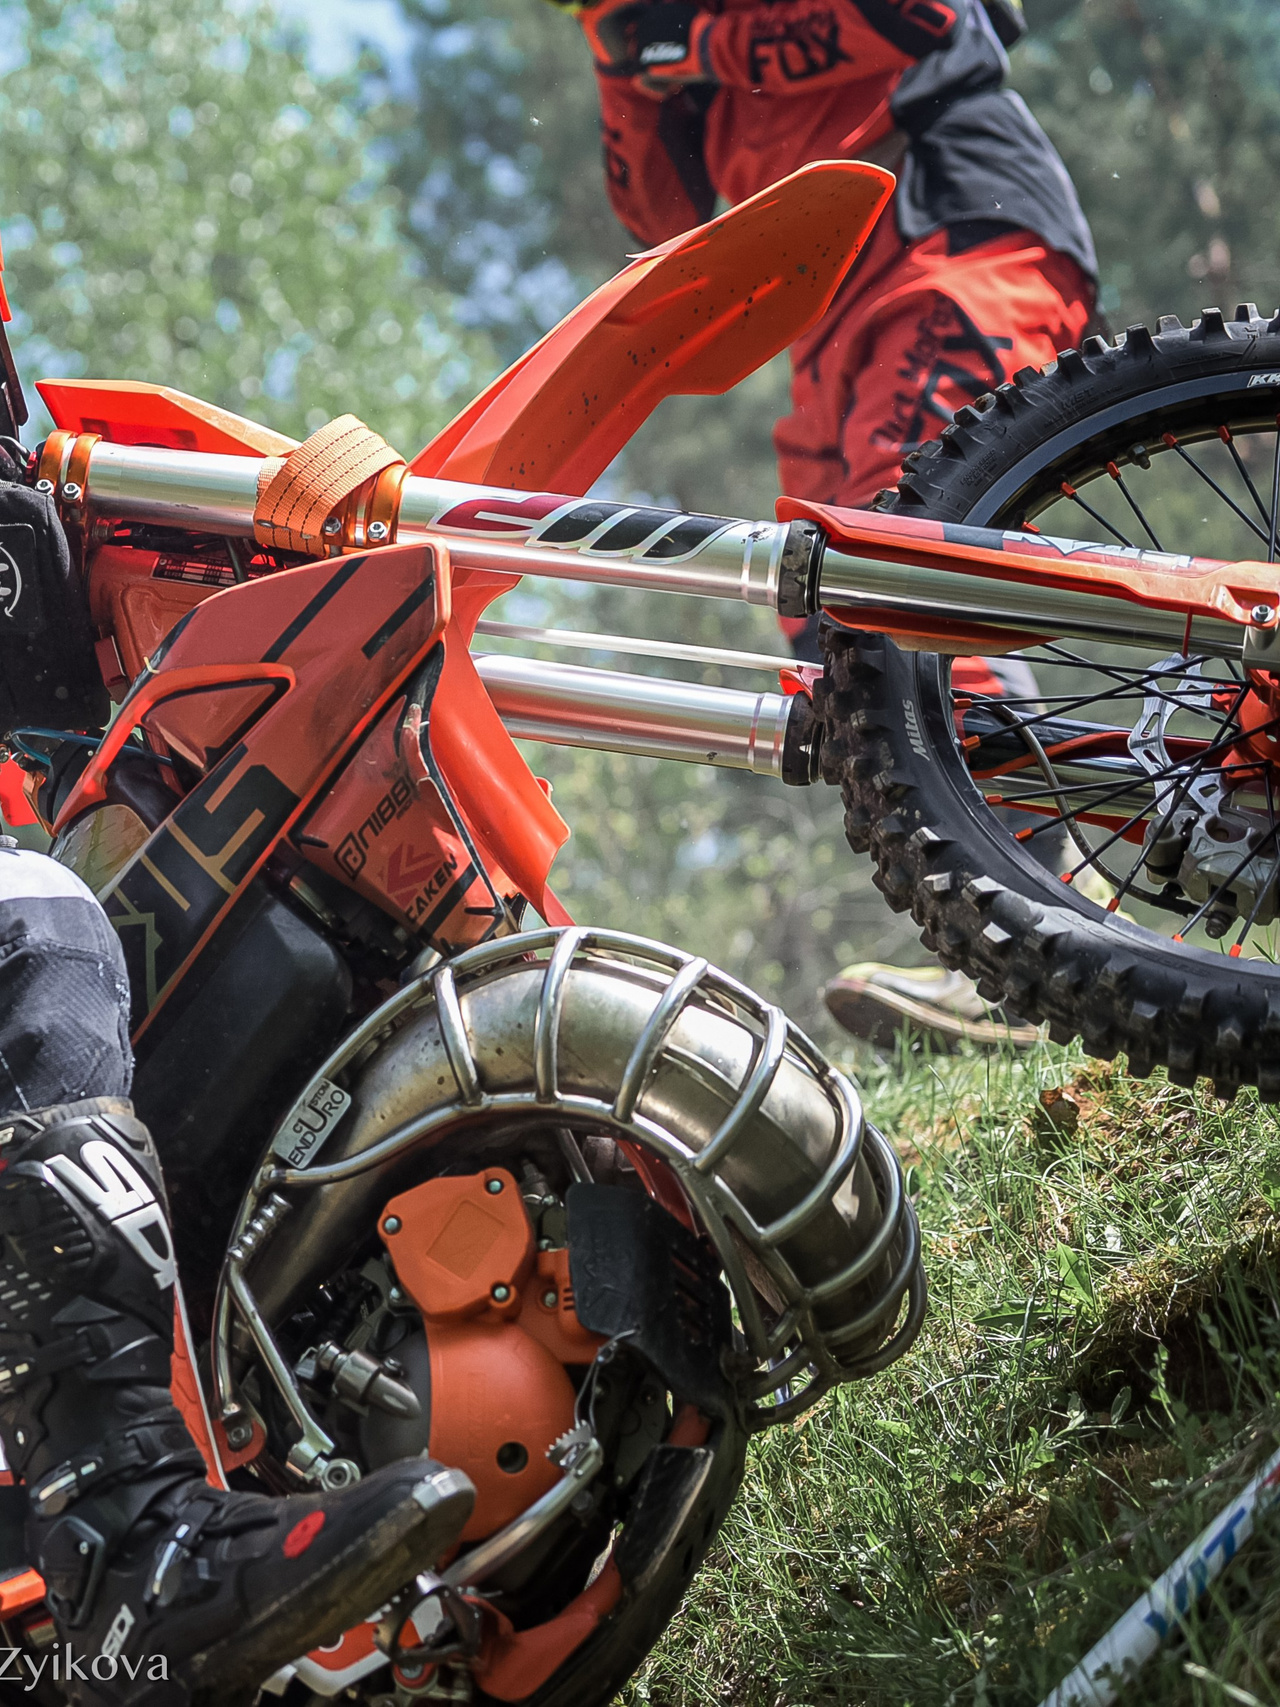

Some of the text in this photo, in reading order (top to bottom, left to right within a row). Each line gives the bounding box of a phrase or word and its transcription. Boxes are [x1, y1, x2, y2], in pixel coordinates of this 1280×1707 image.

[749, 22, 854, 83] FOX
[902, 699, 931, 761] Mitas
[287, 1088, 346, 1166] ENDURO
